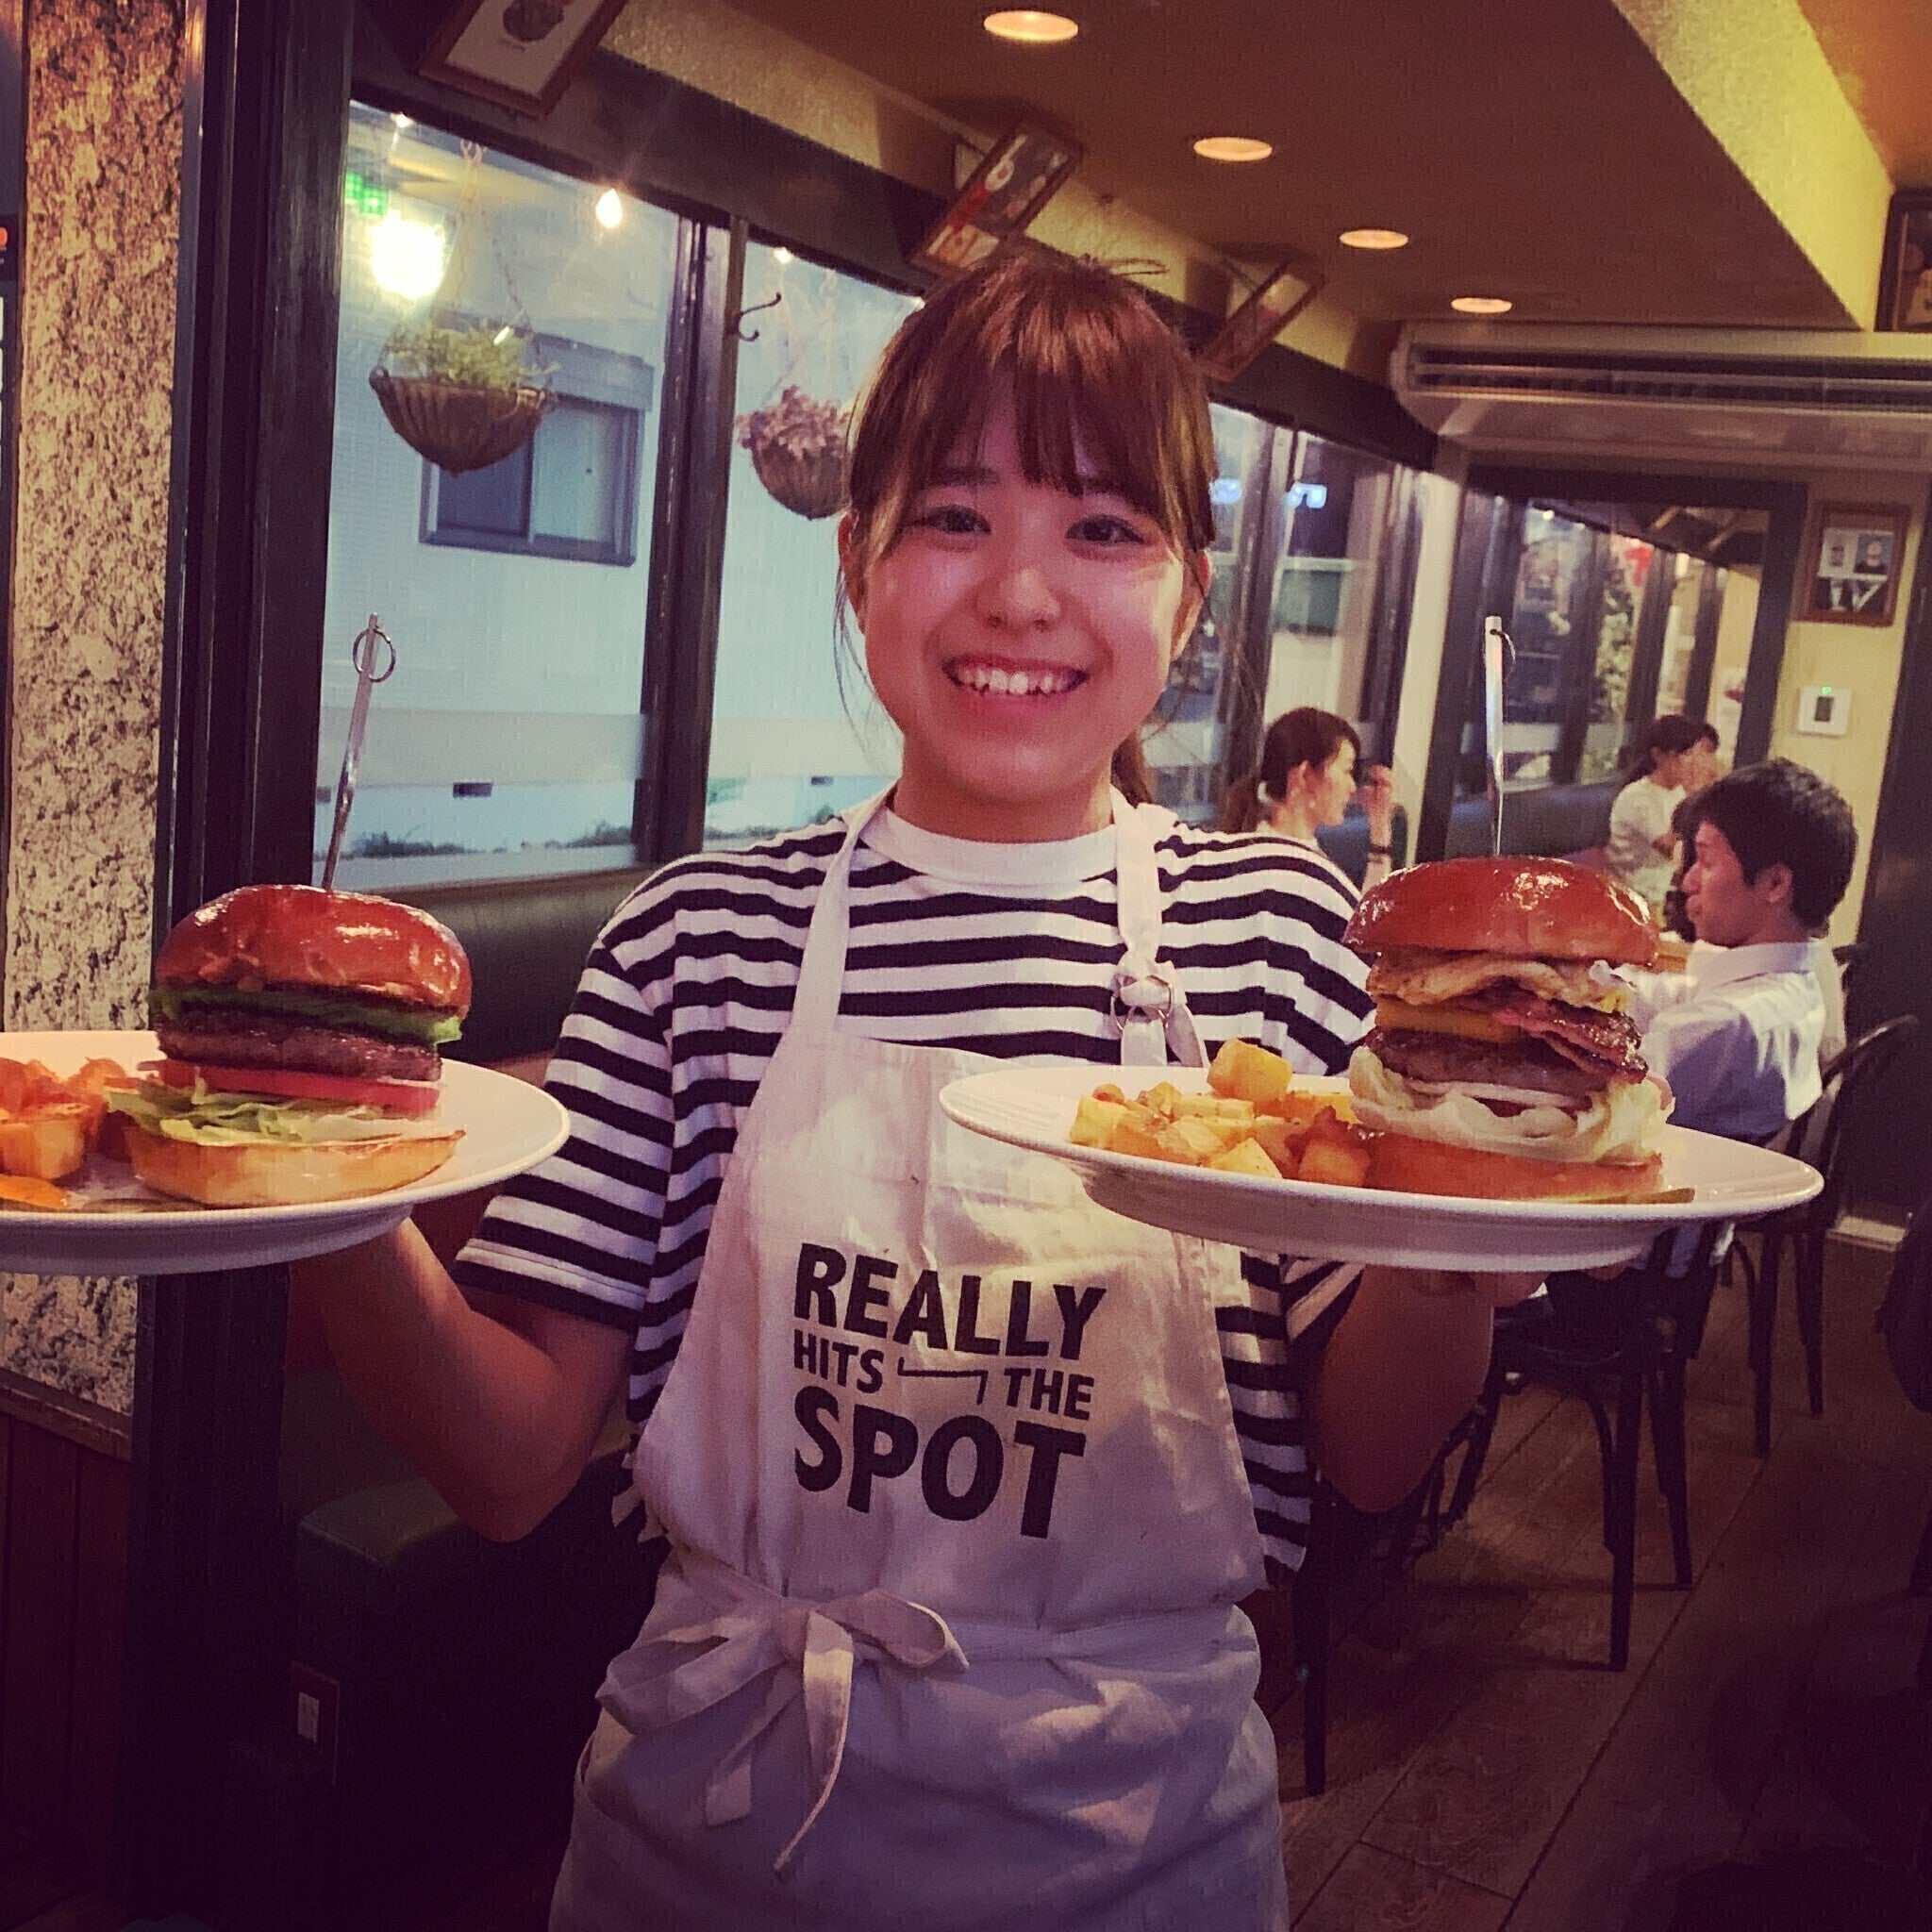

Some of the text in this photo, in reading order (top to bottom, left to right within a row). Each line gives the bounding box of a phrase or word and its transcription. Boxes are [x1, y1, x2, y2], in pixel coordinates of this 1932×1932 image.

[793, 1242, 1107, 1360] REALLY
[793, 1328, 1095, 1422] HITS THE
[793, 1385, 1088, 1540] SPOT
